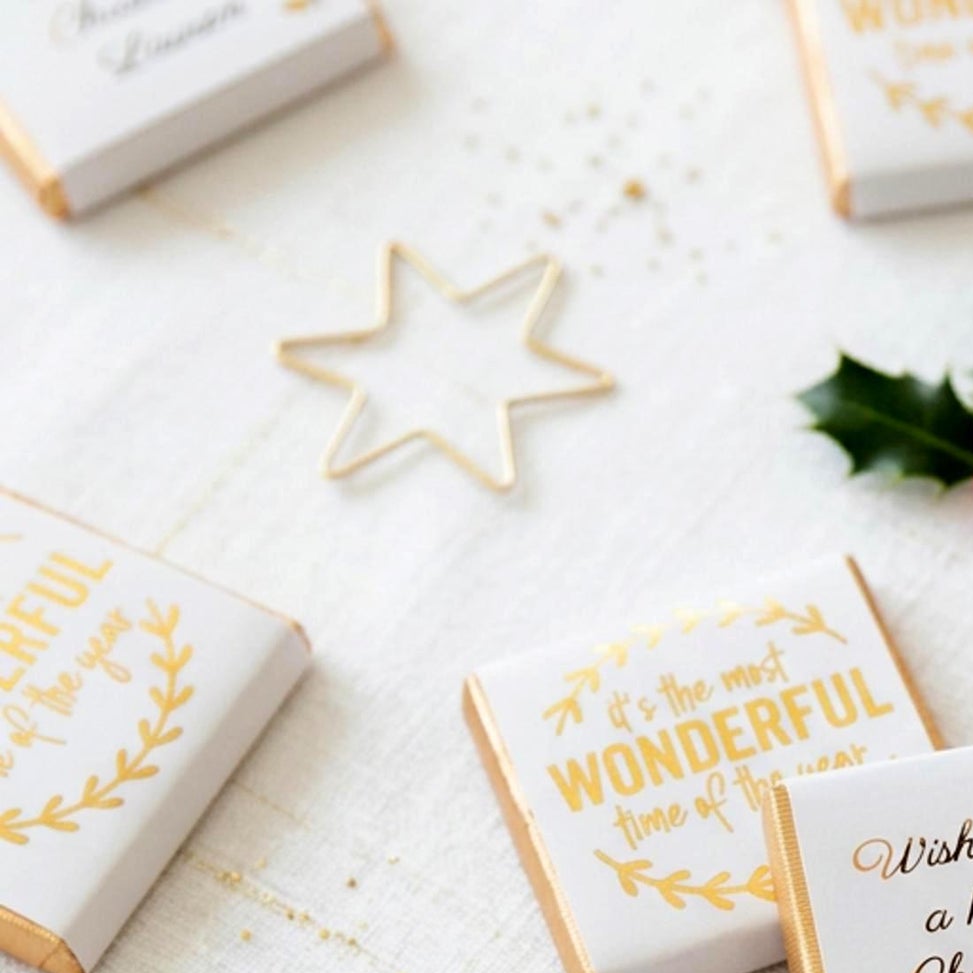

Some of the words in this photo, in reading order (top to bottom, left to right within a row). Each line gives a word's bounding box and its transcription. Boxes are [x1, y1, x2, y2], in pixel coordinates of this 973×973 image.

[607, 691, 656, 732] it's
[658, 673, 713, 717] the
[720, 641, 788, 692] most
[546, 667, 894, 813] WONDERFUL
[613, 803, 688, 850] time
[695, 773, 734, 834] of
[924, 908, 954, 932] a
